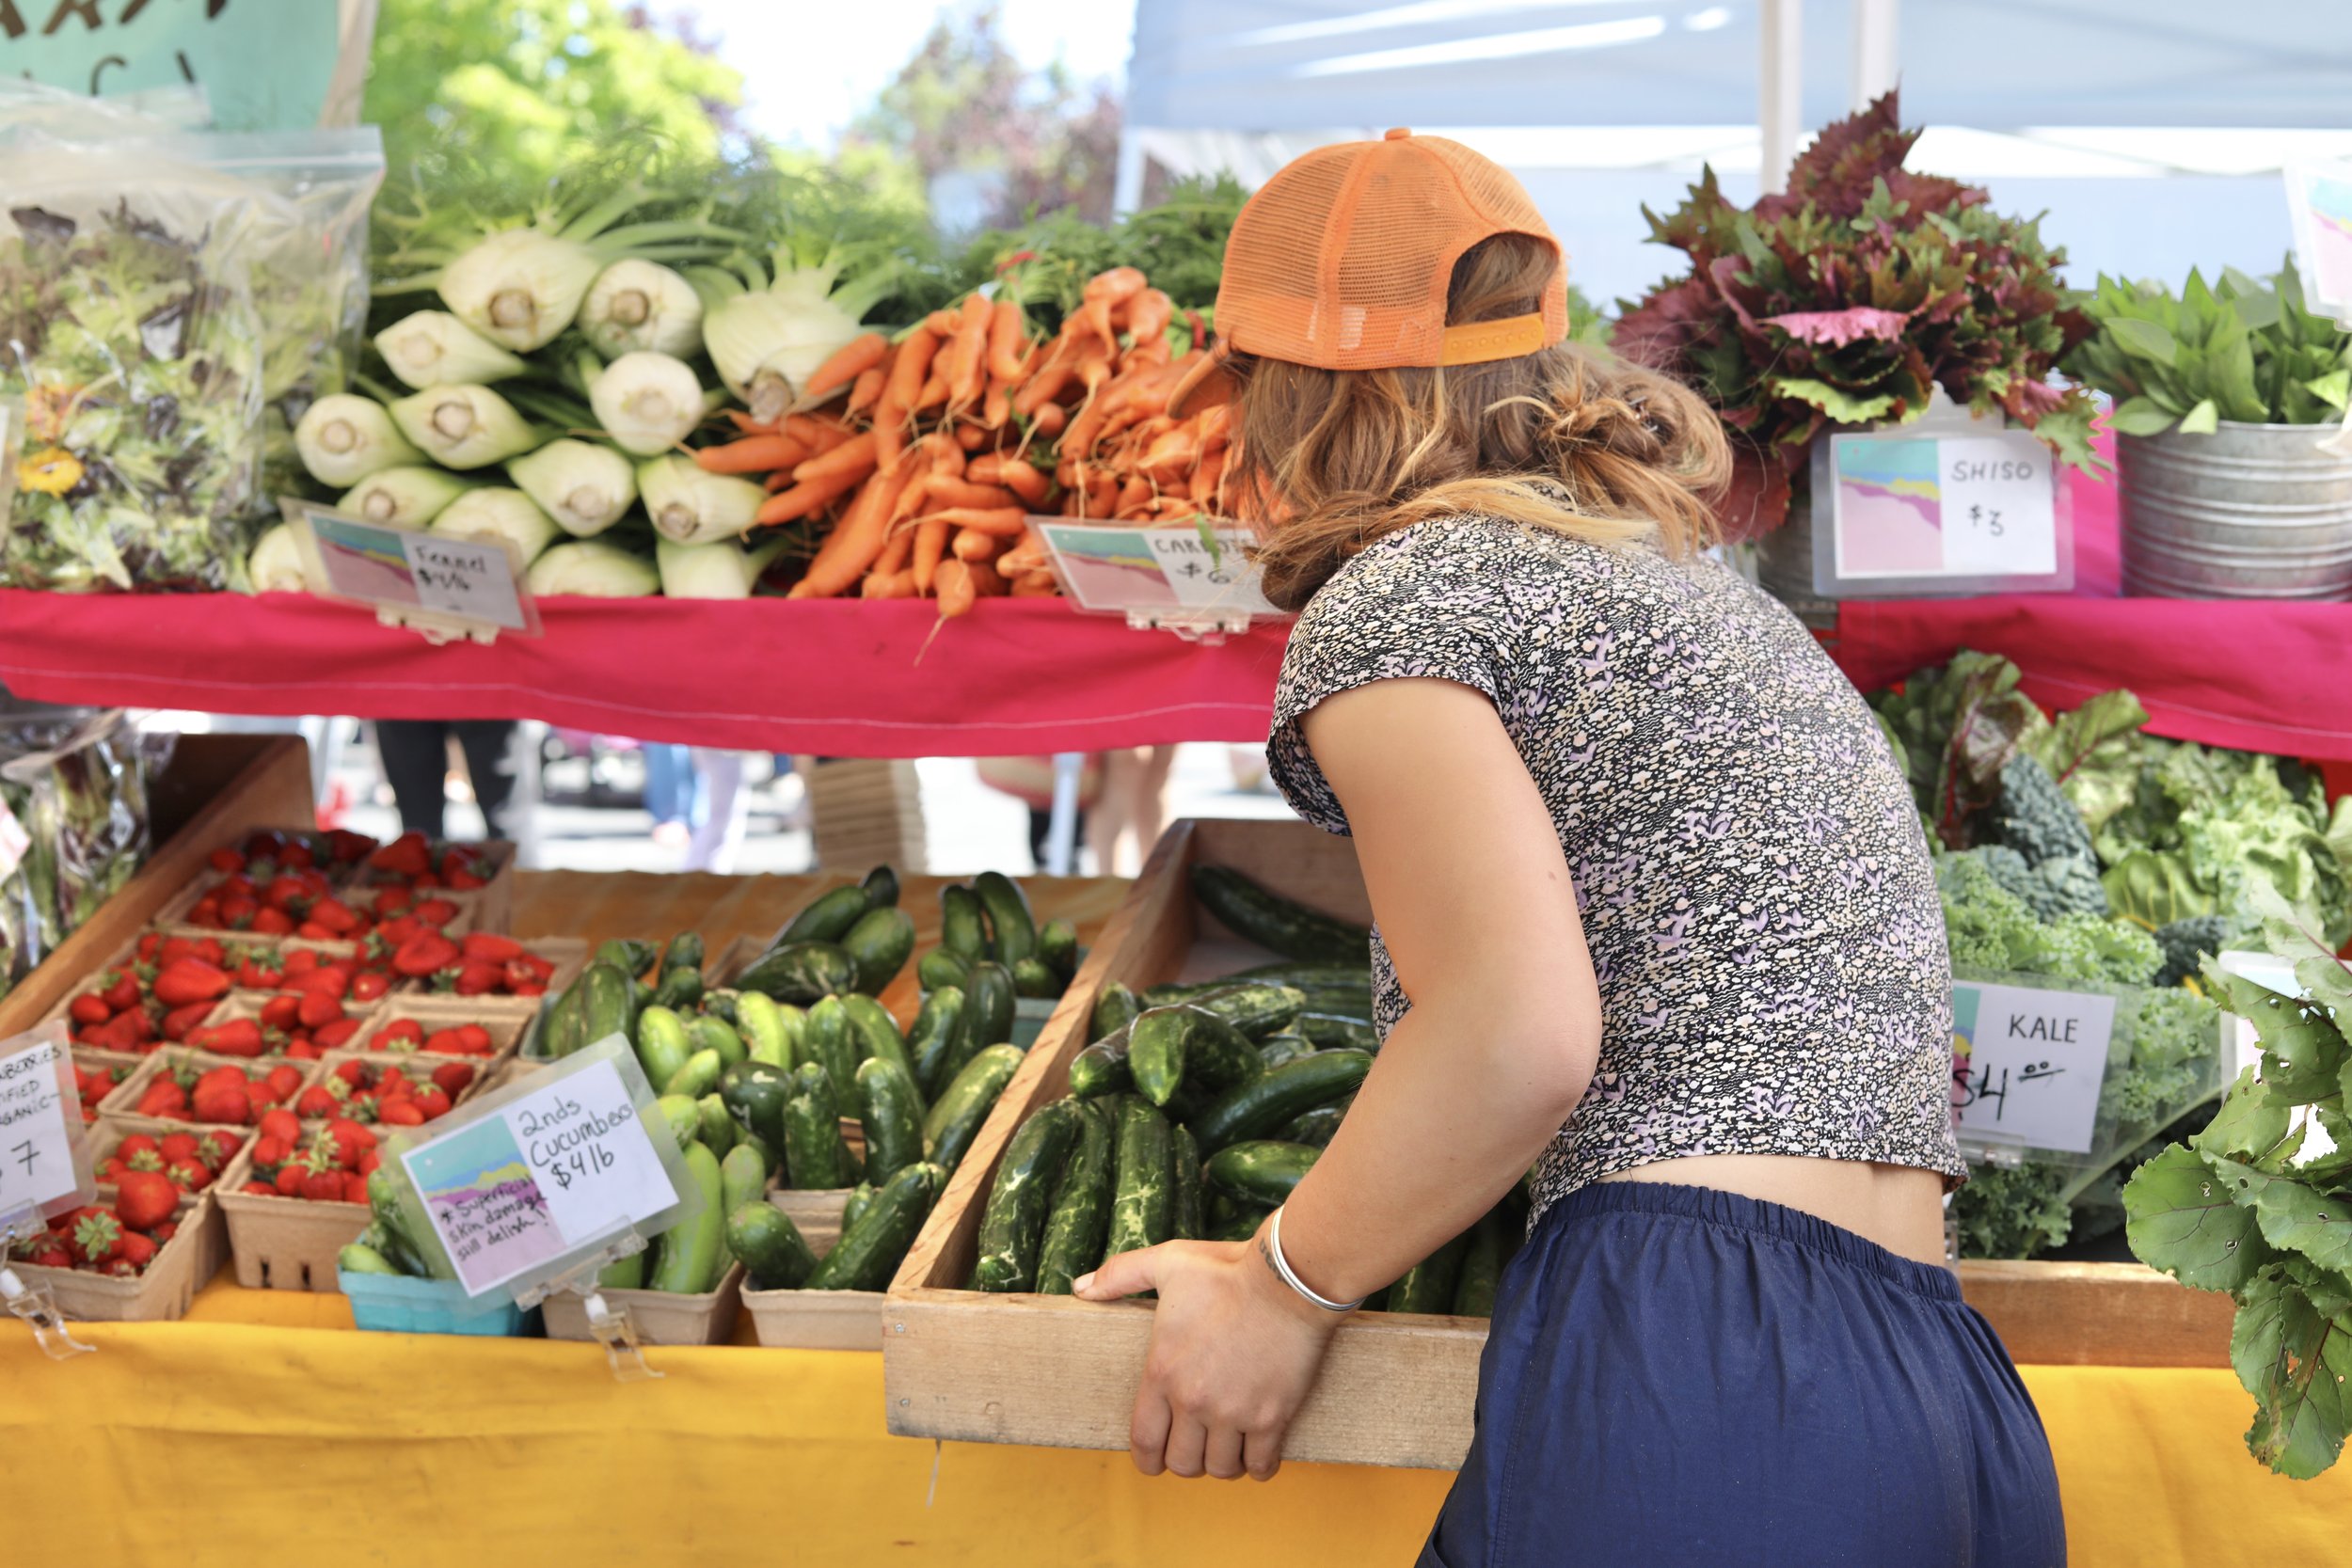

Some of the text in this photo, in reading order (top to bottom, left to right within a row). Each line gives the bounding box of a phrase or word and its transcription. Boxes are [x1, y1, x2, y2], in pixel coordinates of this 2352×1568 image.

[1950, 460, 2034, 482] SHISO
[1968, 504, 2005, 536] $3
[2009, 1013, 2079, 1044] KALE
[517, 1096, 582, 1137] 2nds
[449, 1190, 548, 1243] skin damage
